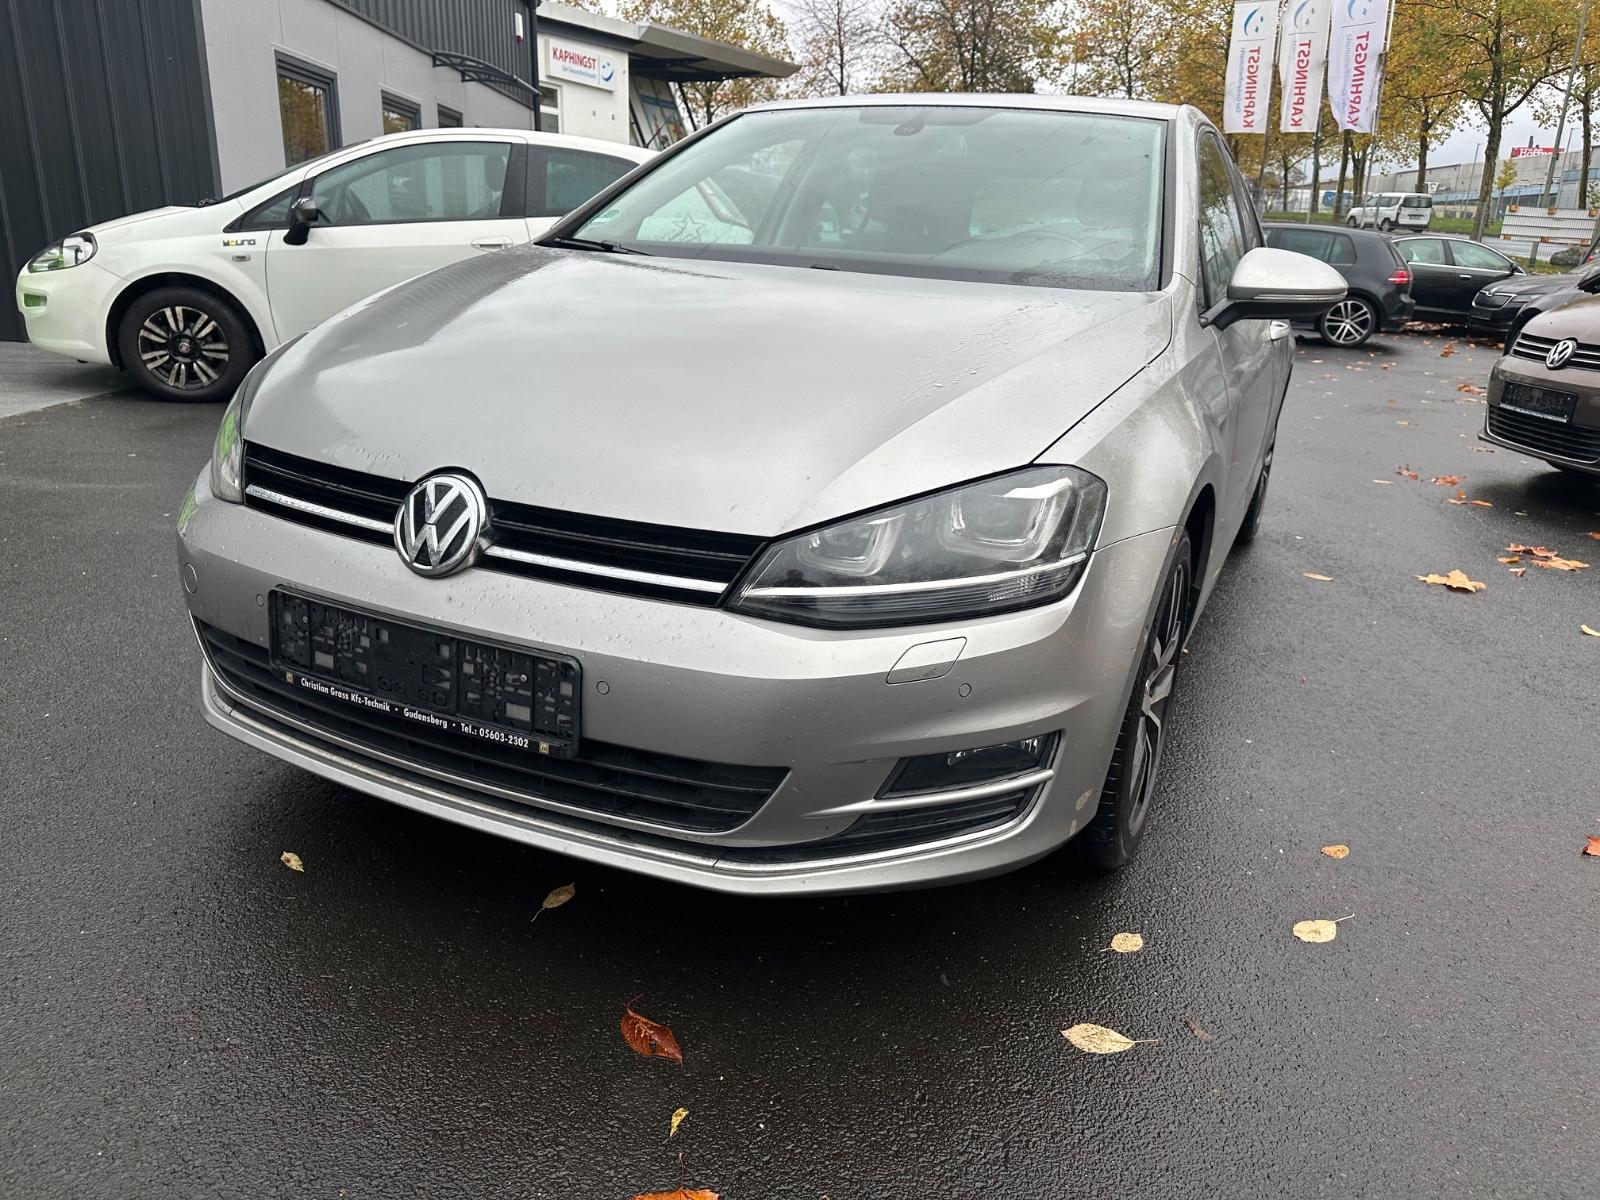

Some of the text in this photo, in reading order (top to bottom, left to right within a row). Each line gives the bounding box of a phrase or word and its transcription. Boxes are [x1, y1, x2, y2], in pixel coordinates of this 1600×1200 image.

[552, 47, 596, 70] KAPHINGST
[1547, 340, 1575, 367] VW
[396, 476, 479, 573] VW
[300, 677, 329, 694] Christian
[330, 687, 349, 700] Grass
[350, 692, 391, 712] Kfz-Technik
[403, 708, 448, 729] Gudensberg
[460, 722, 477, 735] Tel.:
[479, 727, 529, 748] 05603-2302
